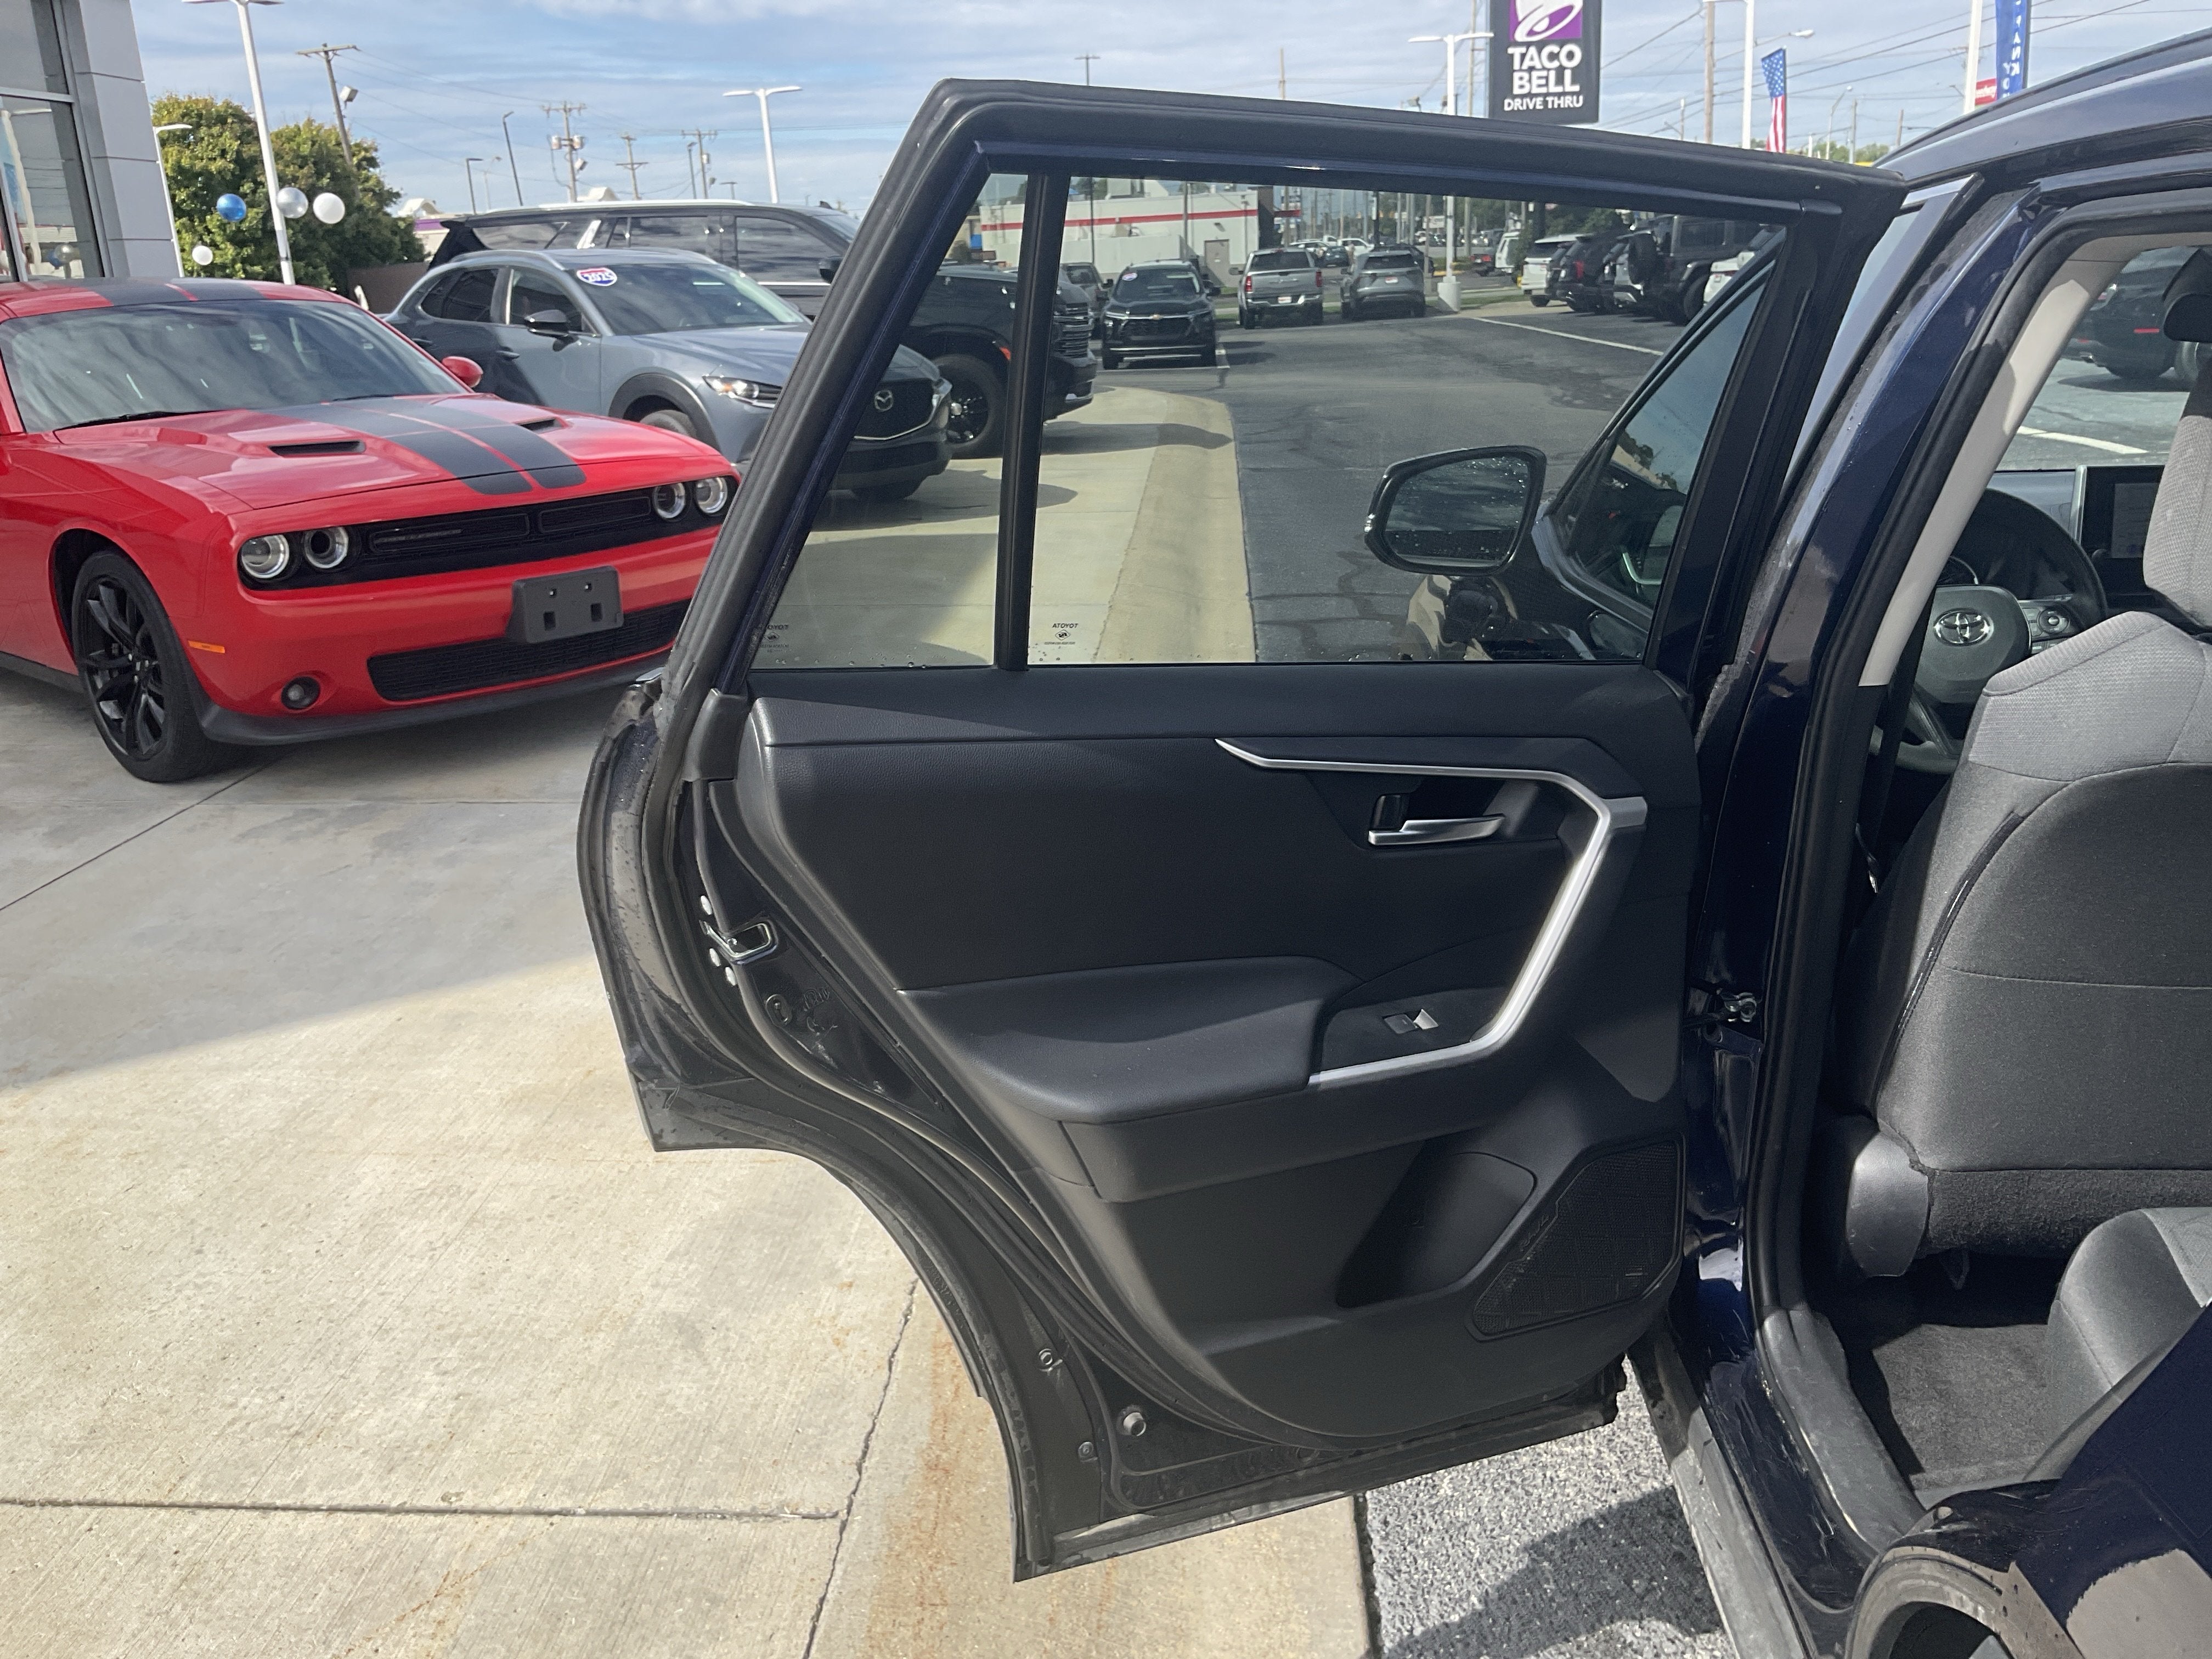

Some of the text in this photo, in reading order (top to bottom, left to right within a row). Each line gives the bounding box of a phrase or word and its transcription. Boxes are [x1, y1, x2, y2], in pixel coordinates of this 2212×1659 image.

[1507, 43, 1582, 70] TACO
[1513, 69, 1581, 95] BELL
[1504, 94, 1584, 111] DRIVE THRU
